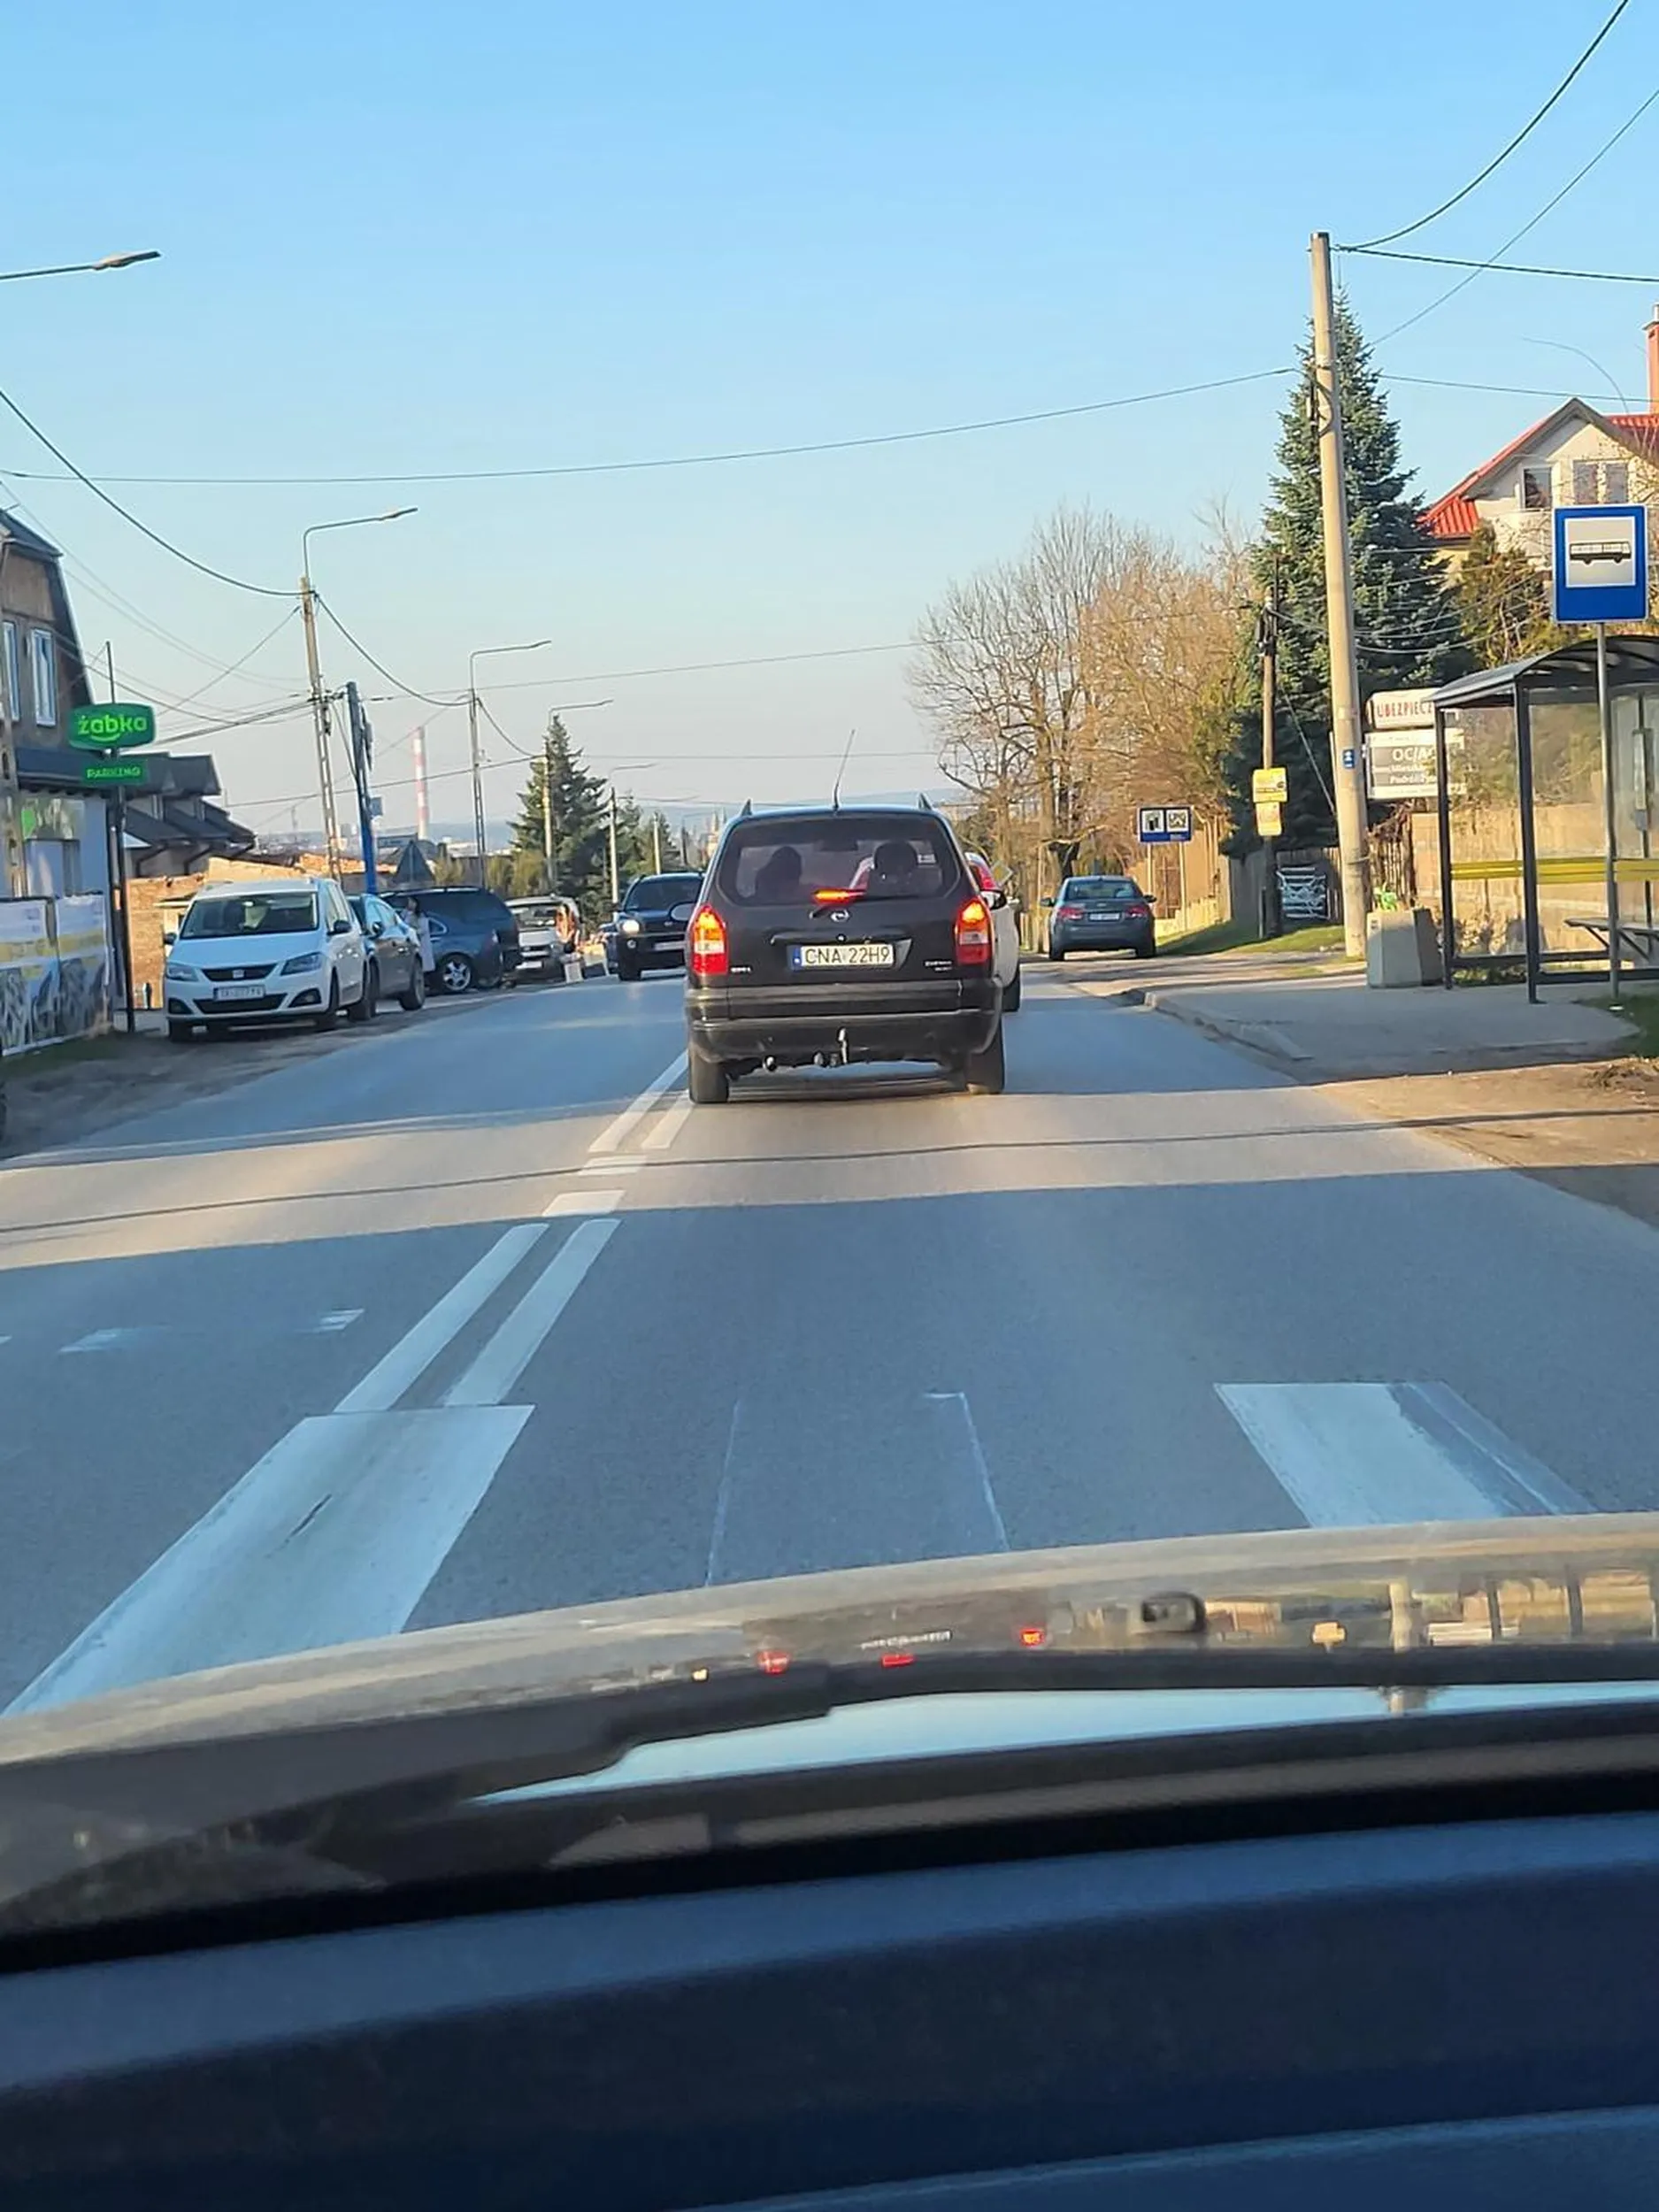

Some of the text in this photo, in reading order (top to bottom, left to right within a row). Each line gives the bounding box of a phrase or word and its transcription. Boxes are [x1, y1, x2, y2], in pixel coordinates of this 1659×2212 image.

[78, 714, 148, 735] żabka
[805, 946, 890, 964] CNA 22H9
